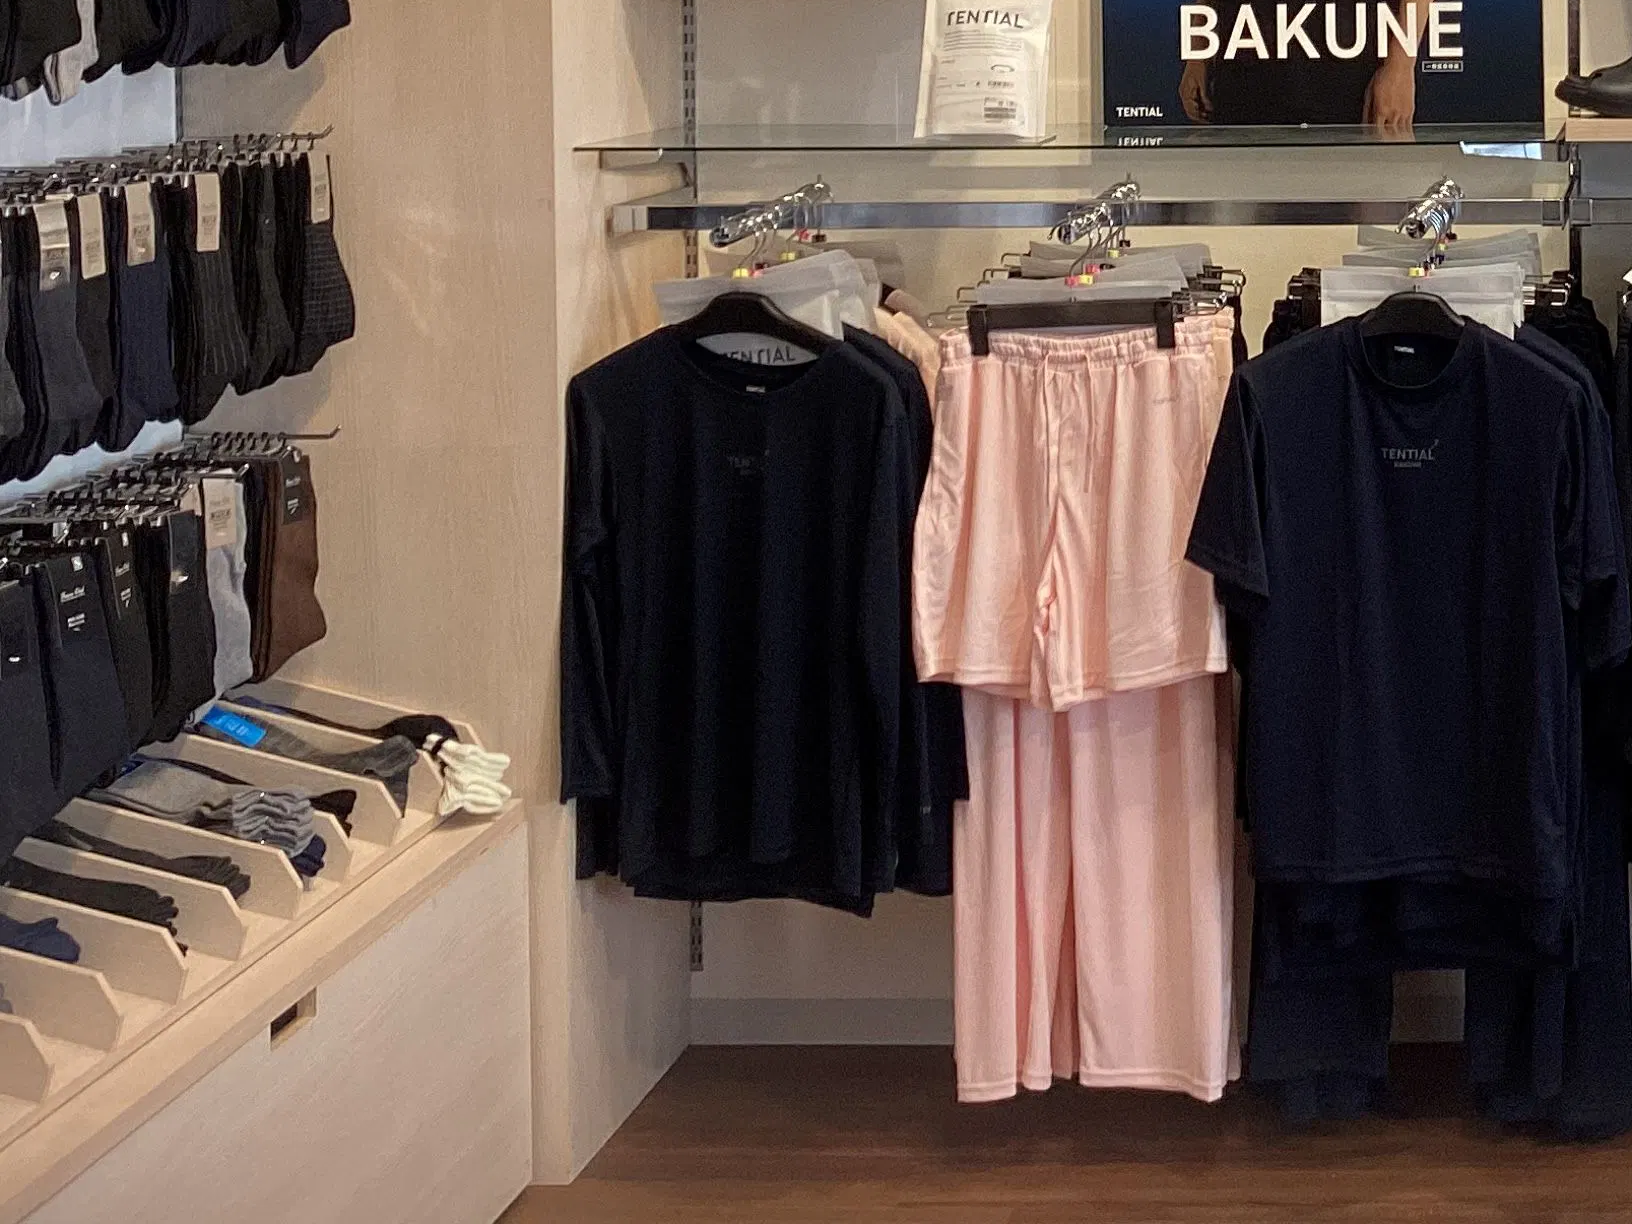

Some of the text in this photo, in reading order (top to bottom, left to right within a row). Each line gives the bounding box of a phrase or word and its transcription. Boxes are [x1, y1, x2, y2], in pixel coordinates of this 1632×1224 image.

[946, 9, 1025, 29] TENTIAL
[1179, 1, 1464, 61] BAKUNE
[1115, 106, 1164, 117] TENTIAL
[1381, 447, 1435, 461] TENTIAL
